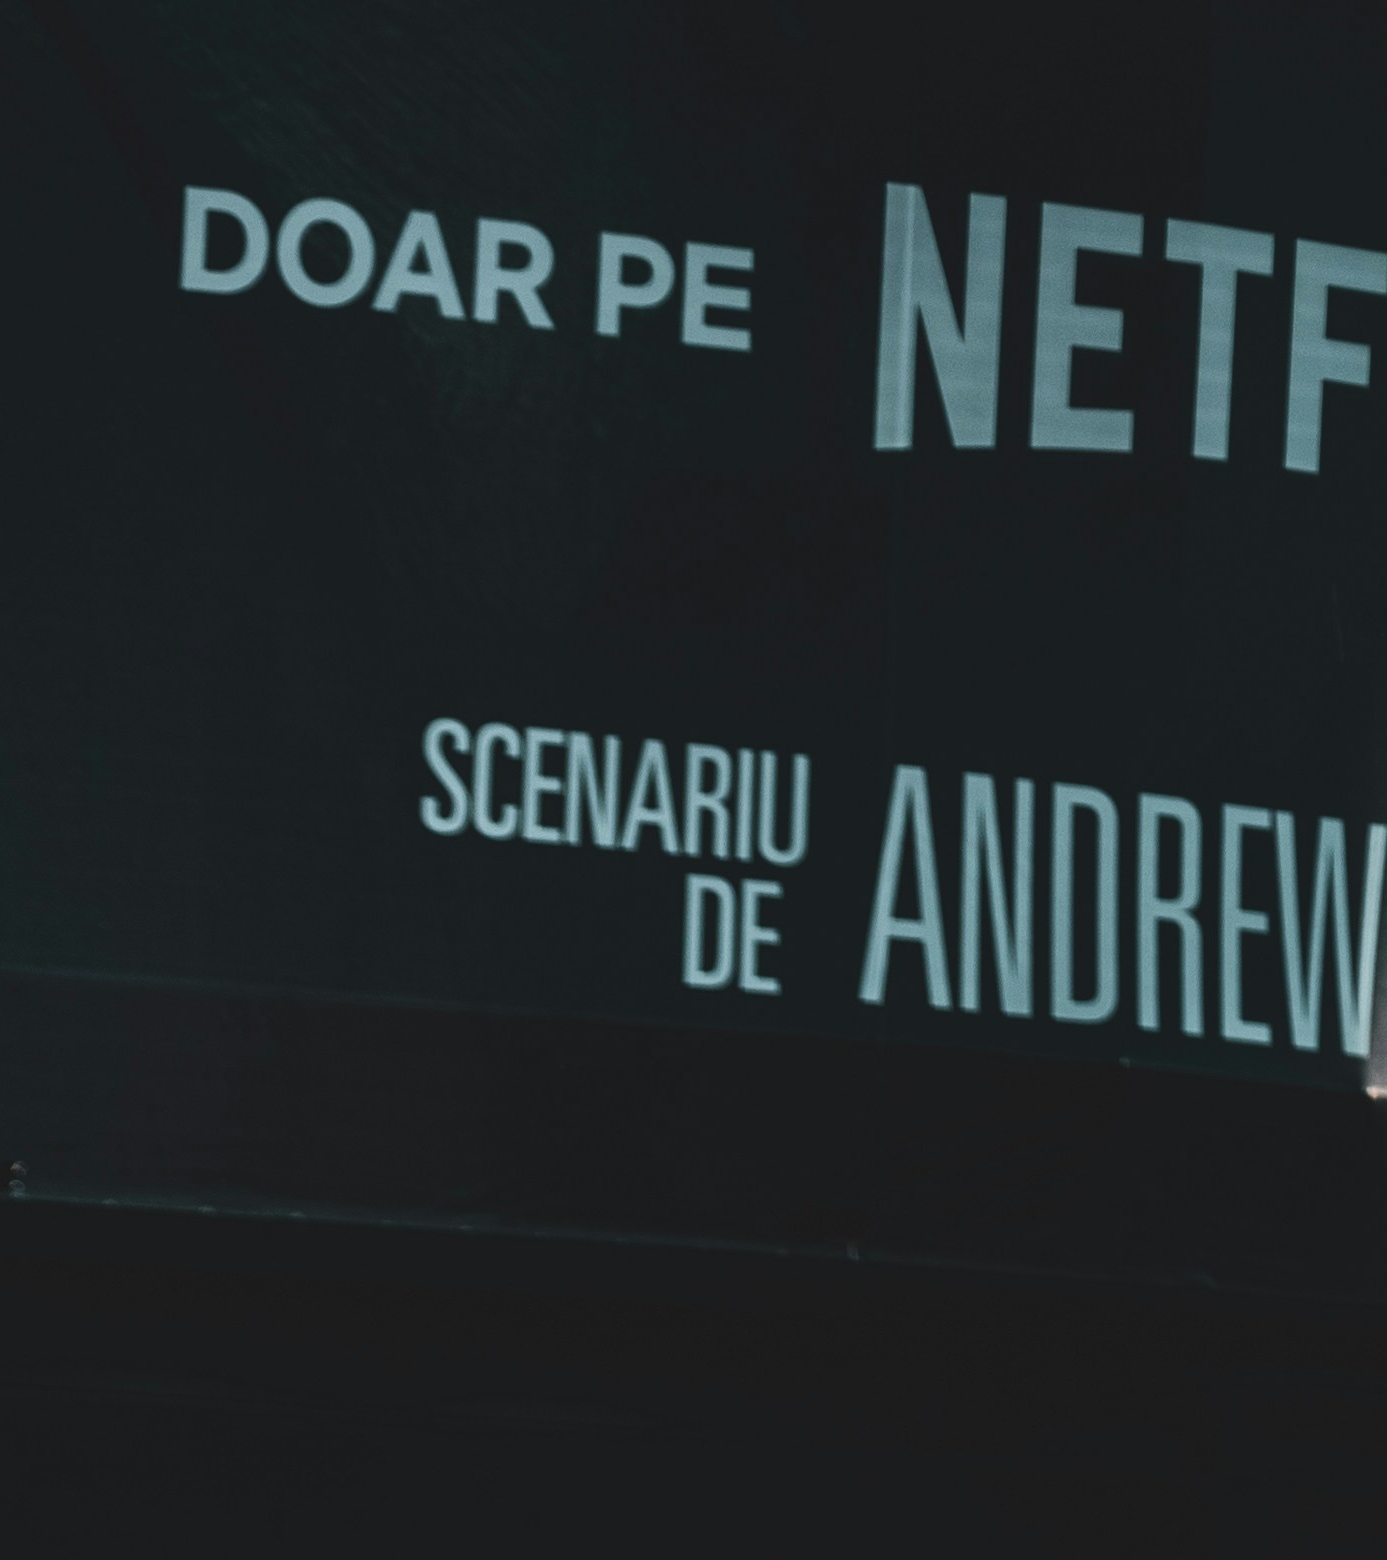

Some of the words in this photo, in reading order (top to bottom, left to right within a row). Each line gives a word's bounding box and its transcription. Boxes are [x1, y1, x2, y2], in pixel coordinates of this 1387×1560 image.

[180, 184, 556, 331] DOAR
[595, 231, 755, 352] PE
[873, 181, 1387, 475] NETF
[420, 717, 812, 867] SCENARIU
[682, 873, 783, 994] DE
[859, 763, 1387, 1057] ANDREW
